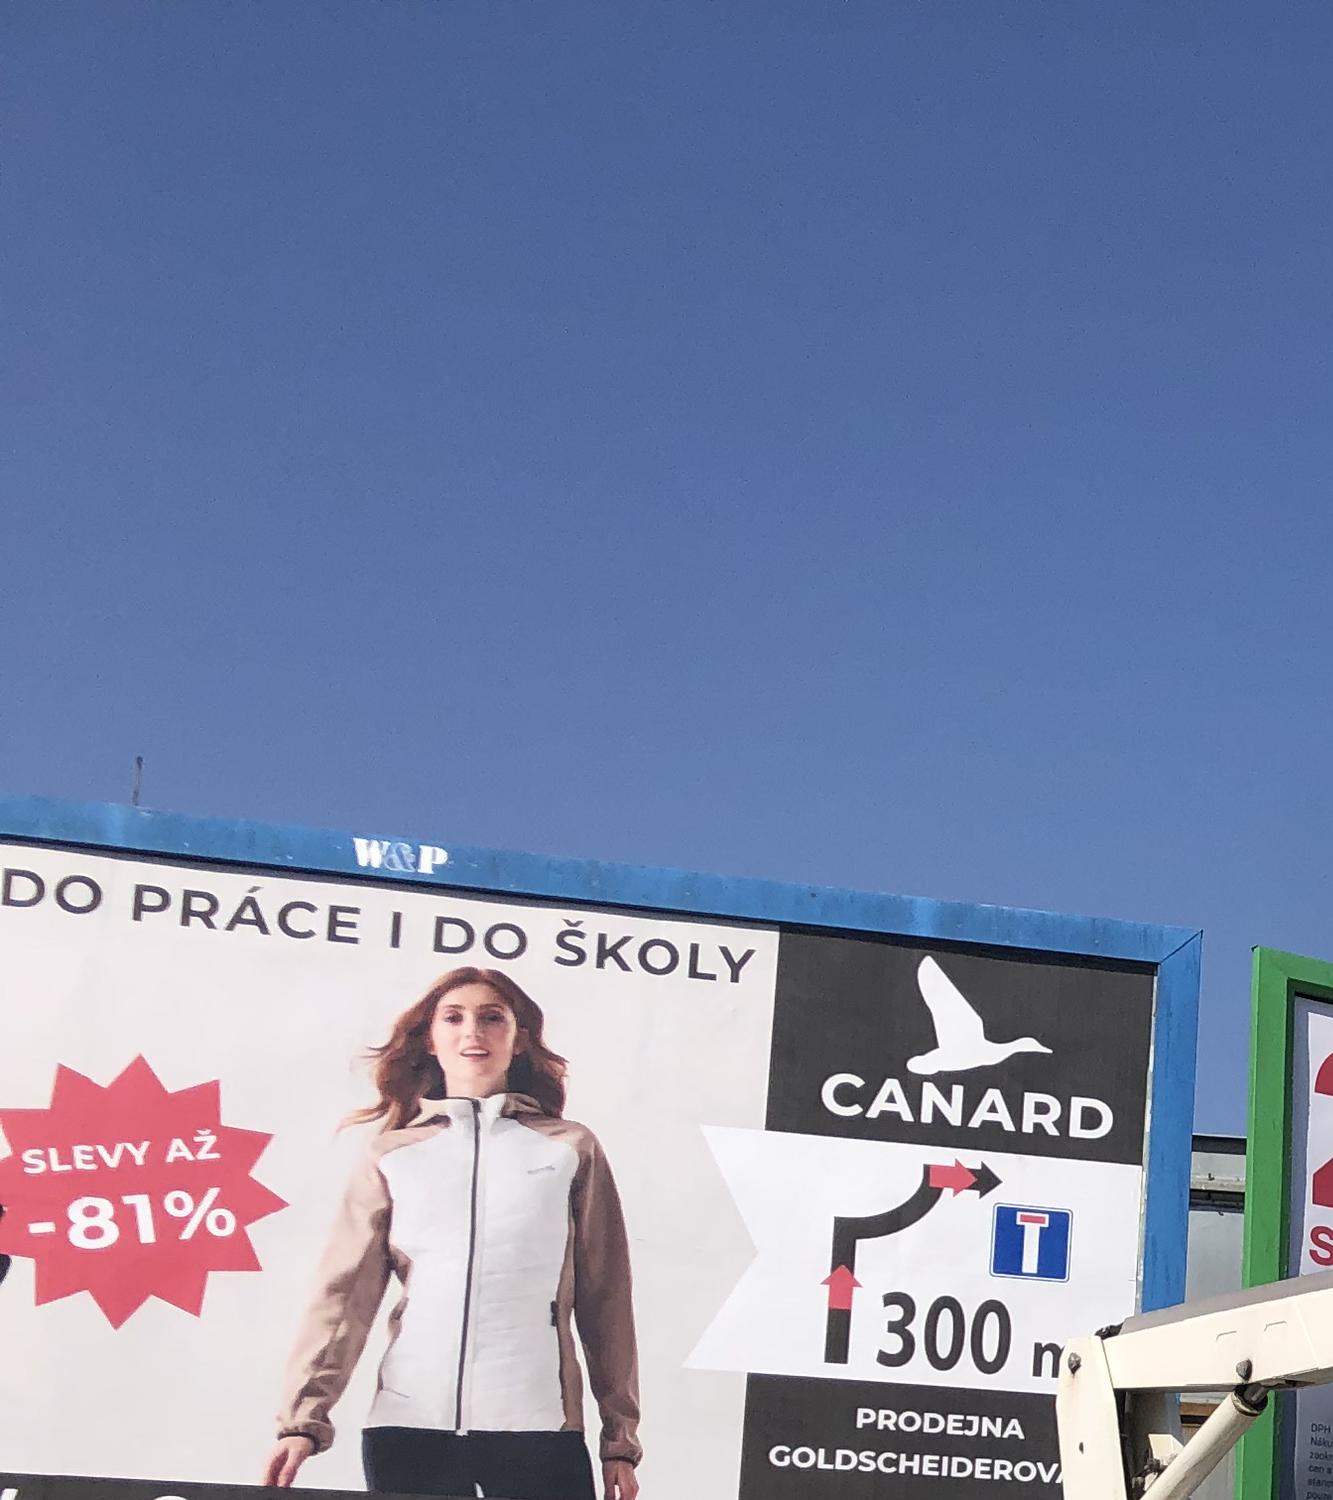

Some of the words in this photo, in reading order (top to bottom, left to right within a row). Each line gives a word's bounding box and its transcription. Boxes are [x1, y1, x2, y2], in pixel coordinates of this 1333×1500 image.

[353, 836, 448, 875] W&P
[2, 867, 102, 915] DO
[132, 885, 361, 946] PRÁCE
[389, 910, 402, 949] I
[433, 916, 528, 961] DO
[554, 919, 757, 984] ŠKOLY
[820, 1072, 1115, 1140] CANARD
[21, 1143, 148, 1175] SLEVY
[165, 1132, 221, 1164] AŽ
[28, 1186, 237, 1251] -81%
[876, 1291, 1012, 1374] 300
[855, 1407, 1025, 1441] PRODEJNA
